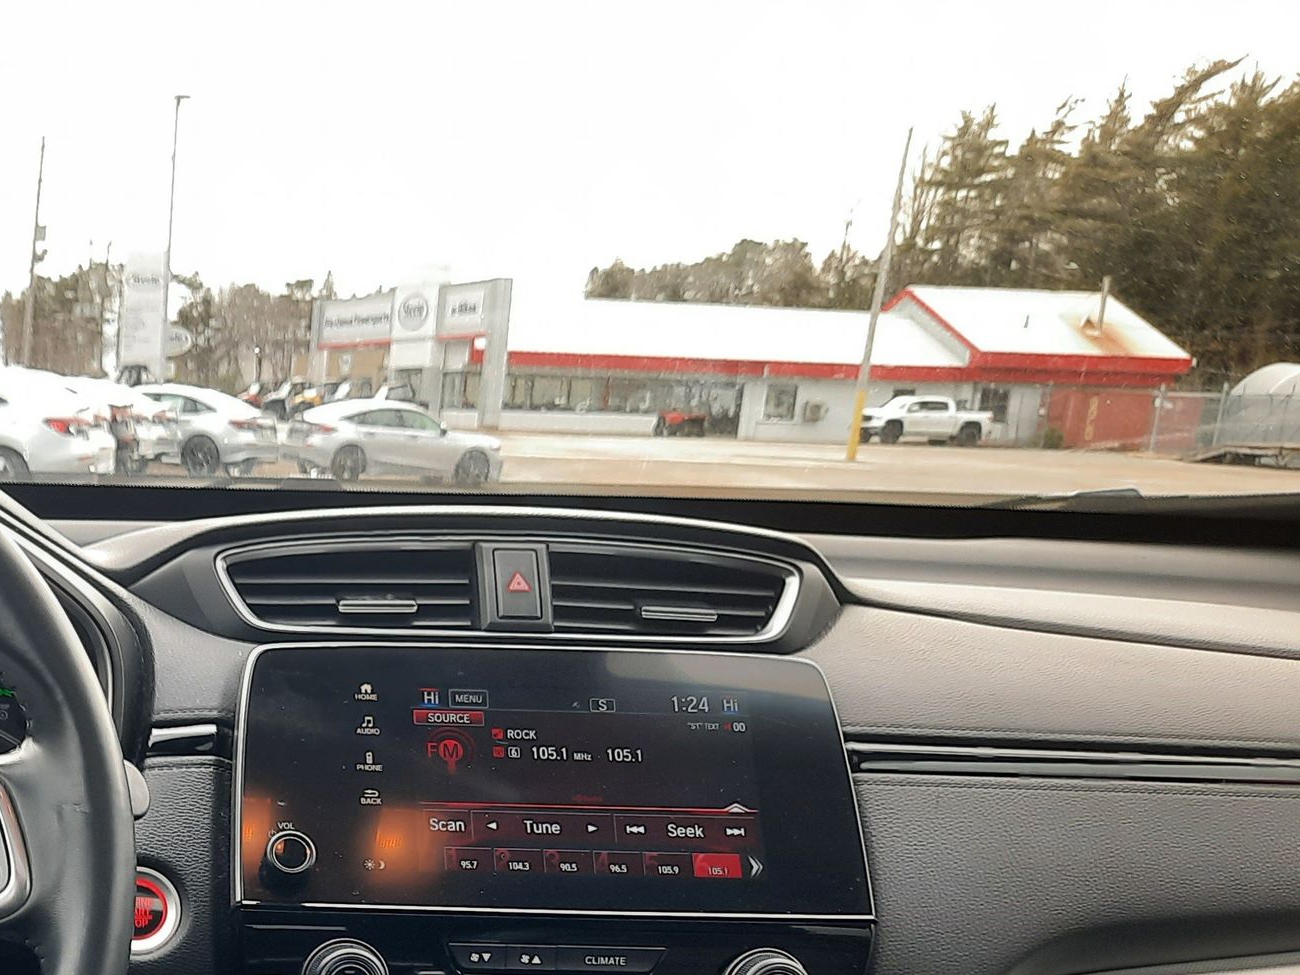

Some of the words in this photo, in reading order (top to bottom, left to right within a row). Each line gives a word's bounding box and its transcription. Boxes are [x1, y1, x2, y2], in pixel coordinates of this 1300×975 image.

[354, 693, 379, 701] HOME
[424, 691, 439, 704] Hi
[455, 694, 483, 704] MENU
[671, 696, 709, 712] 1:24
[723, 699, 739, 712] Hi
[428, 713, 470, 723] SOURCE
[356, 727, 381, 735] AUDIO
[732, 722, 746, 732] 00
[507, 729, 537, 740] ROCK
[427, 742, 461, 759] FM
[532, 746, 567, 760] 105.1
[573, 752, 592, 761] MHz
[606, 748, 643, 762] 105.1
[356, 764, 383, 772] PHONE
[360, 797, 382, 805] BACK
[277, 821, 295, 830] VOL
[429, 818, 465, 832] Scan
[523, 820, 561, 834] Tune
[667, 823, 705, 838] Seek
[460, 860, 478, 869] 95.7
[508, 862, 530, 871] 104.3
[560, 863, 578, 872] 90.5
[609, 864, 628, 873] 96.5
[657, 865, 680, 875] 105.9
[708, 867, 729, 875] 105.1
[585, 956, 627, 966] CLIMATE
